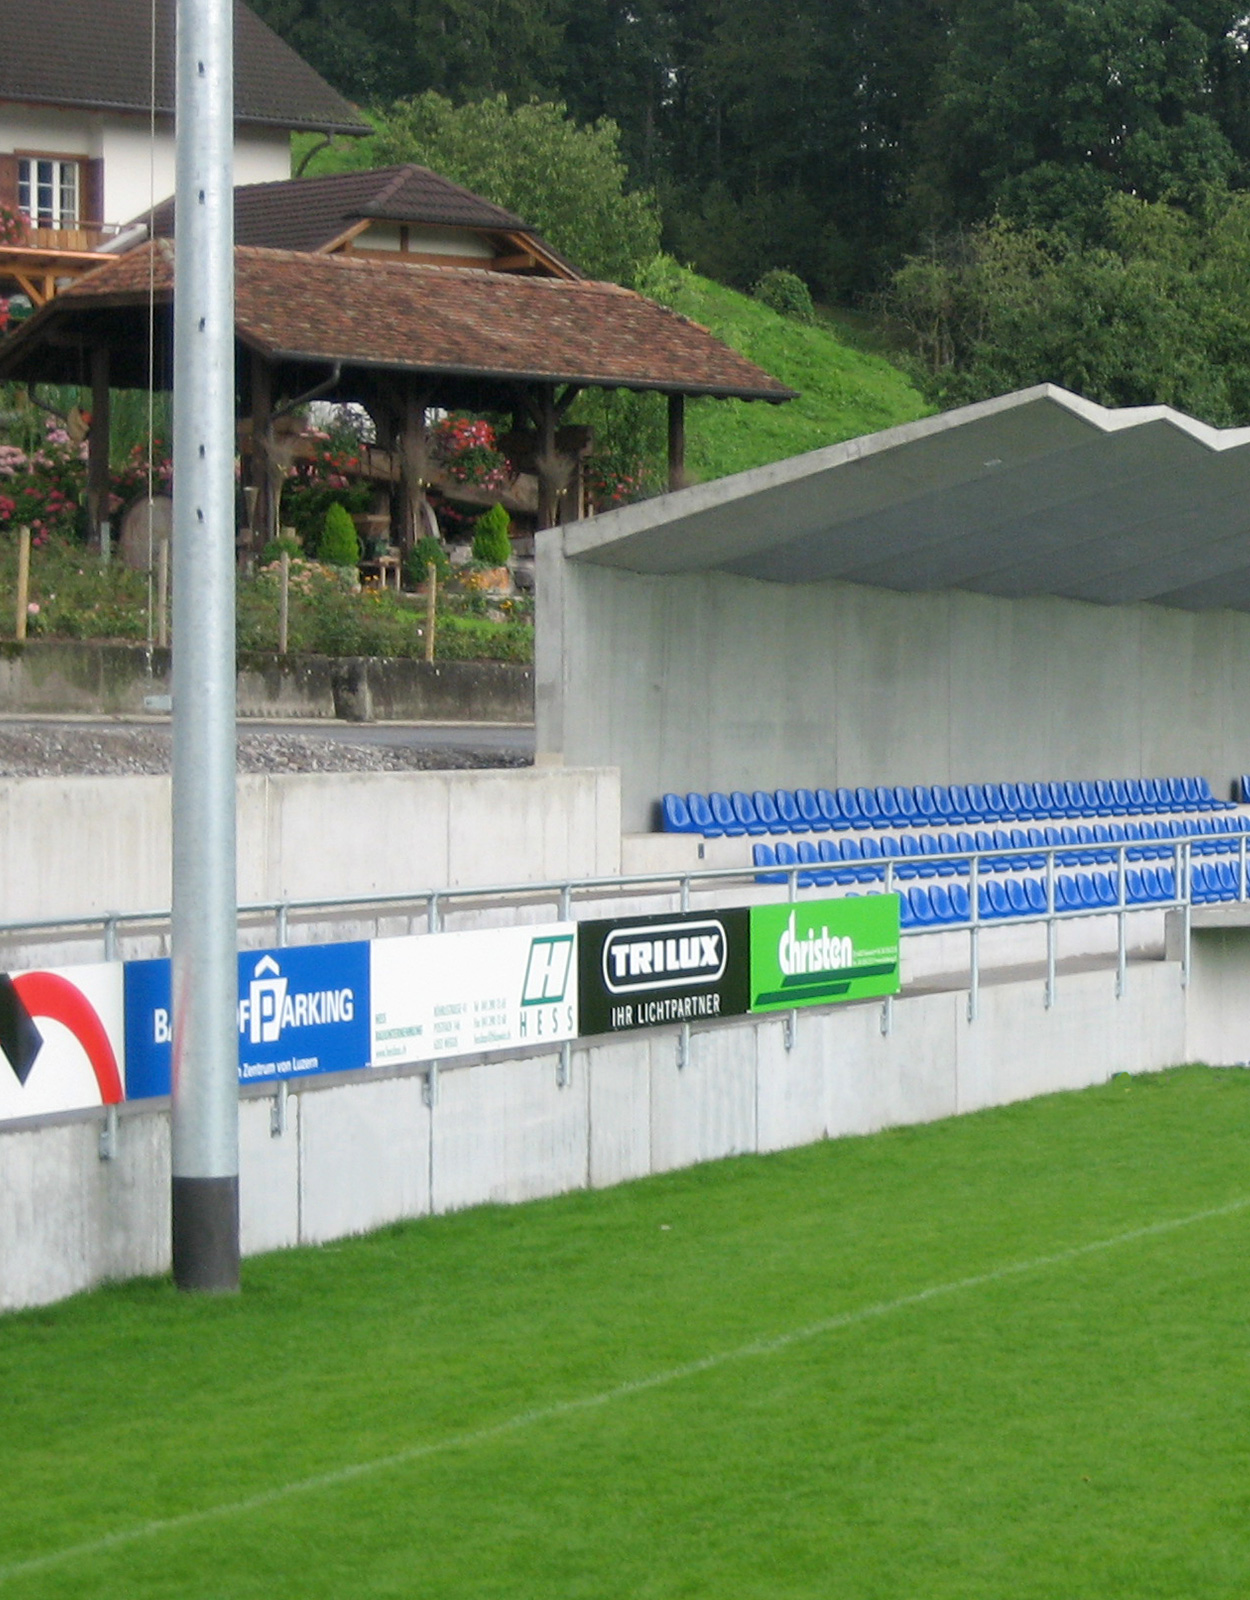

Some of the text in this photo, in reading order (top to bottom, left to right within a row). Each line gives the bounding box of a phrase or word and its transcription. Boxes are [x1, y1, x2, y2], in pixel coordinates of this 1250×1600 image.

[611, 934, 720, 977] TRILUX
[519, 1005, 574, 1037] HESS
[612, 993, 721, 1027] IHR LICHTPARTNER
[242, 1063, 276, 1078] Zentrum
[277, 1061, 292, 1073] von
[293, 1057, 319, 1071] Luzern
